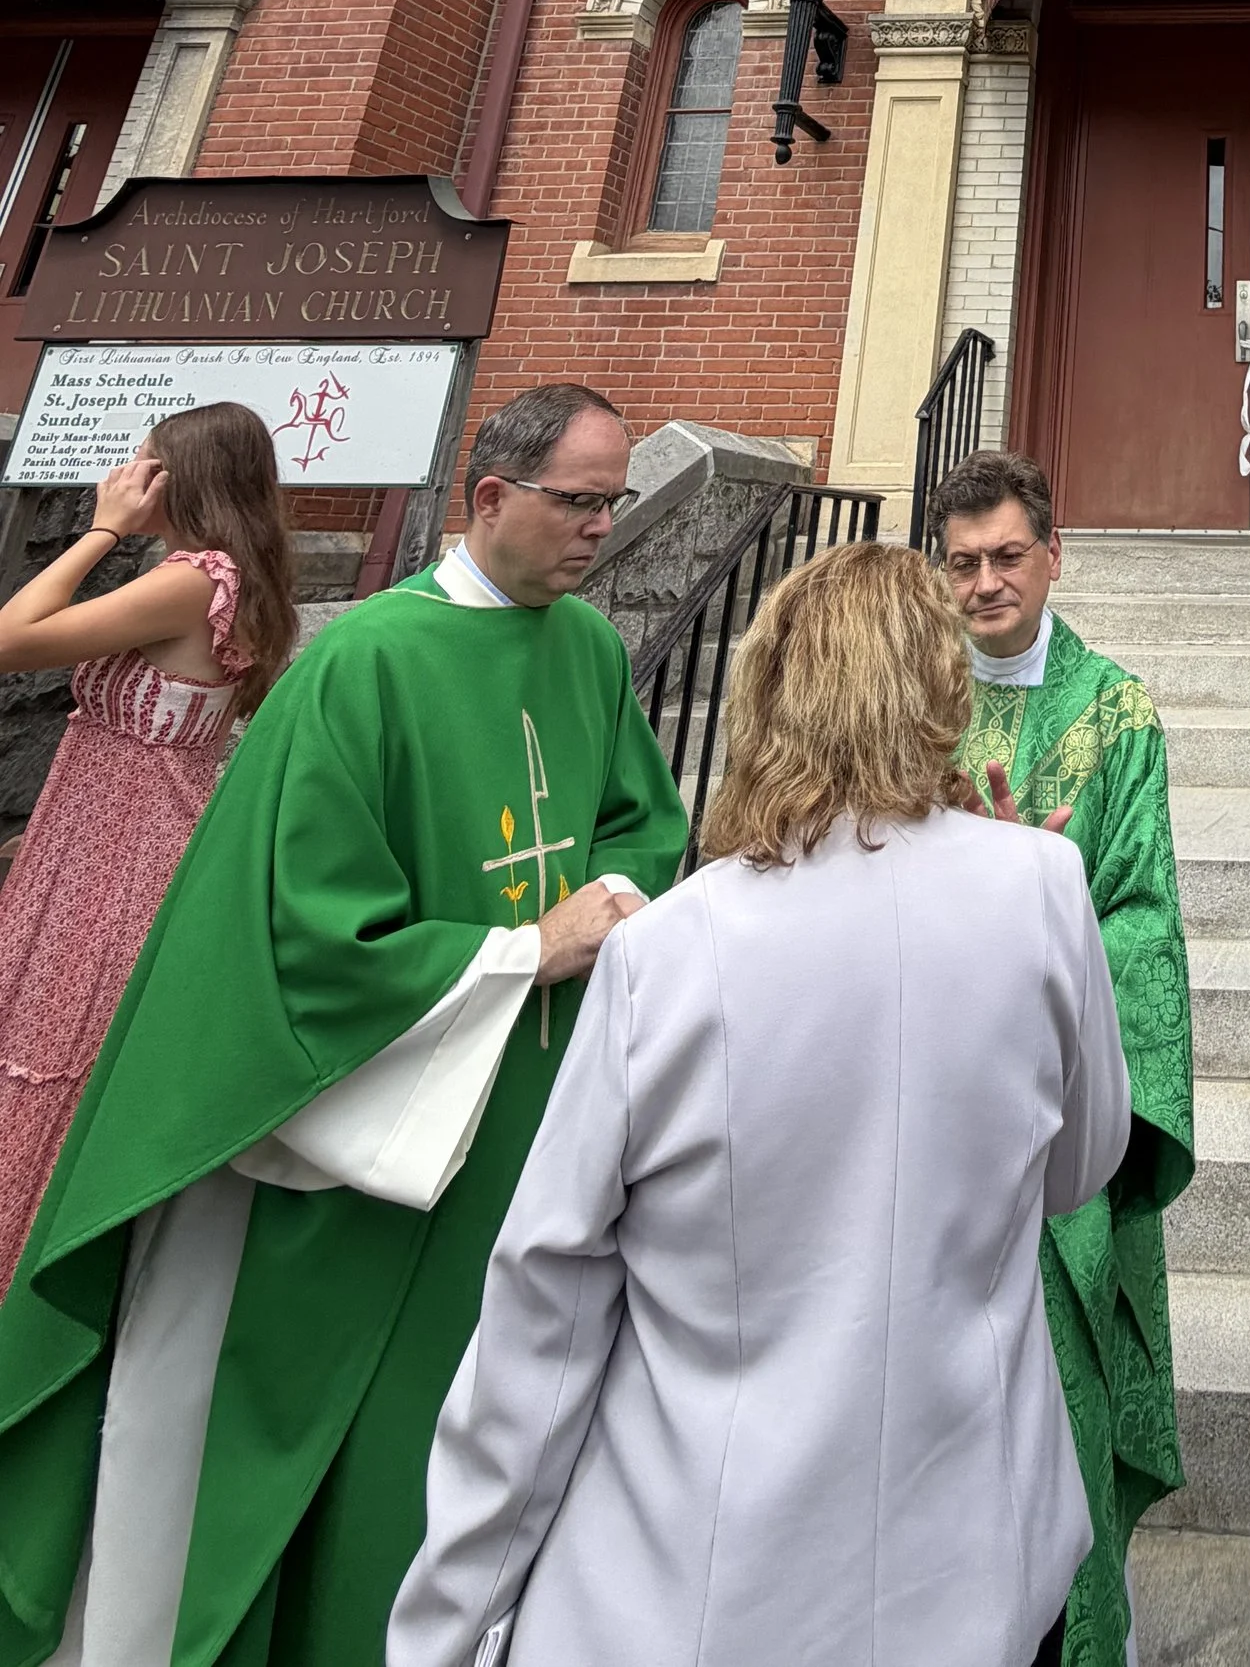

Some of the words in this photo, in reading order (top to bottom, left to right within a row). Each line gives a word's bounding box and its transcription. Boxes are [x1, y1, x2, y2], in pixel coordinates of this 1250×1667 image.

[127, 197, 267, 226] Archdiocese
[280, 198, 306, 234] of
[311, 197, 431, 234] Hartford
[99, 242, 245, 278] SAINT
[266, 241, 443, 276] JOSEPH
[66, 289, 285, 323] LITHUANIAN
[301, 288, 452, 323] CHURCH
[59, 348, 96, 365] First
[98, 348, 171, 365] Lithuanian
[175, 348, 223, 365] Parish
[228, 347, 252, 365] In
[255, 346, 293, 365] New
[297, 346, 362, 366] England,
[368, 346, 402, 364] Est.
[408, 350, 440, 363] 1894
[50, 373, 92, 387] Mass
[95, 373, 174, 387] Schedule
[43, 393, 66, 407] St.
[66, 393, 128, 411] Joseph
[133, 392, 196, 407] Church
[37, 412, 102, 430] Sunday
[31, 433, 61, 444] Daily
[27, 445, 48, 455] Our
[50, 445, 77, 456] Lady
[80, 445, 92, 455] of
[94, 445, 129, 455] Mount
[22, 457, 56, 467] Parish
